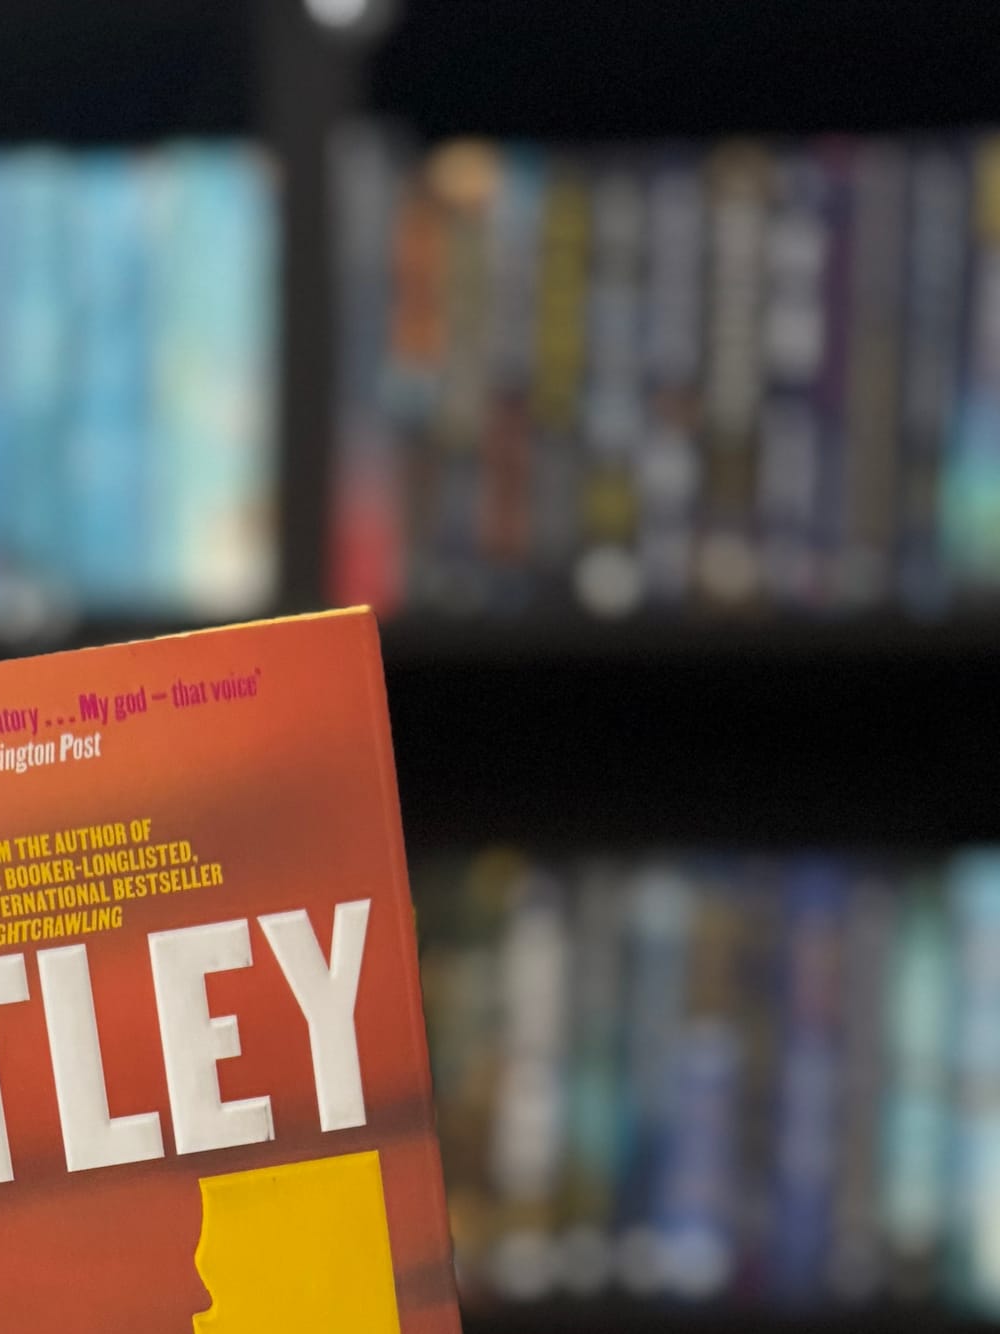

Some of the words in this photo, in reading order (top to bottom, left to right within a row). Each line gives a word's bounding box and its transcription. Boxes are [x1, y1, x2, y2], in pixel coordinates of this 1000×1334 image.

[78, 693, 109, 726] My
[114, 686, 148, 721] god
[171, 679, 208, 708] that
[59, 732, 101, 762] Post
[14, 834, 50, 860] THE
[54, 822, 128, 855] AUTHOR
[130, 819, 152, 842] OF
[4, 841, 199, 891] BOOKER-LONGLISTED,
[113, 863, 223, 901] BESTSELLER
